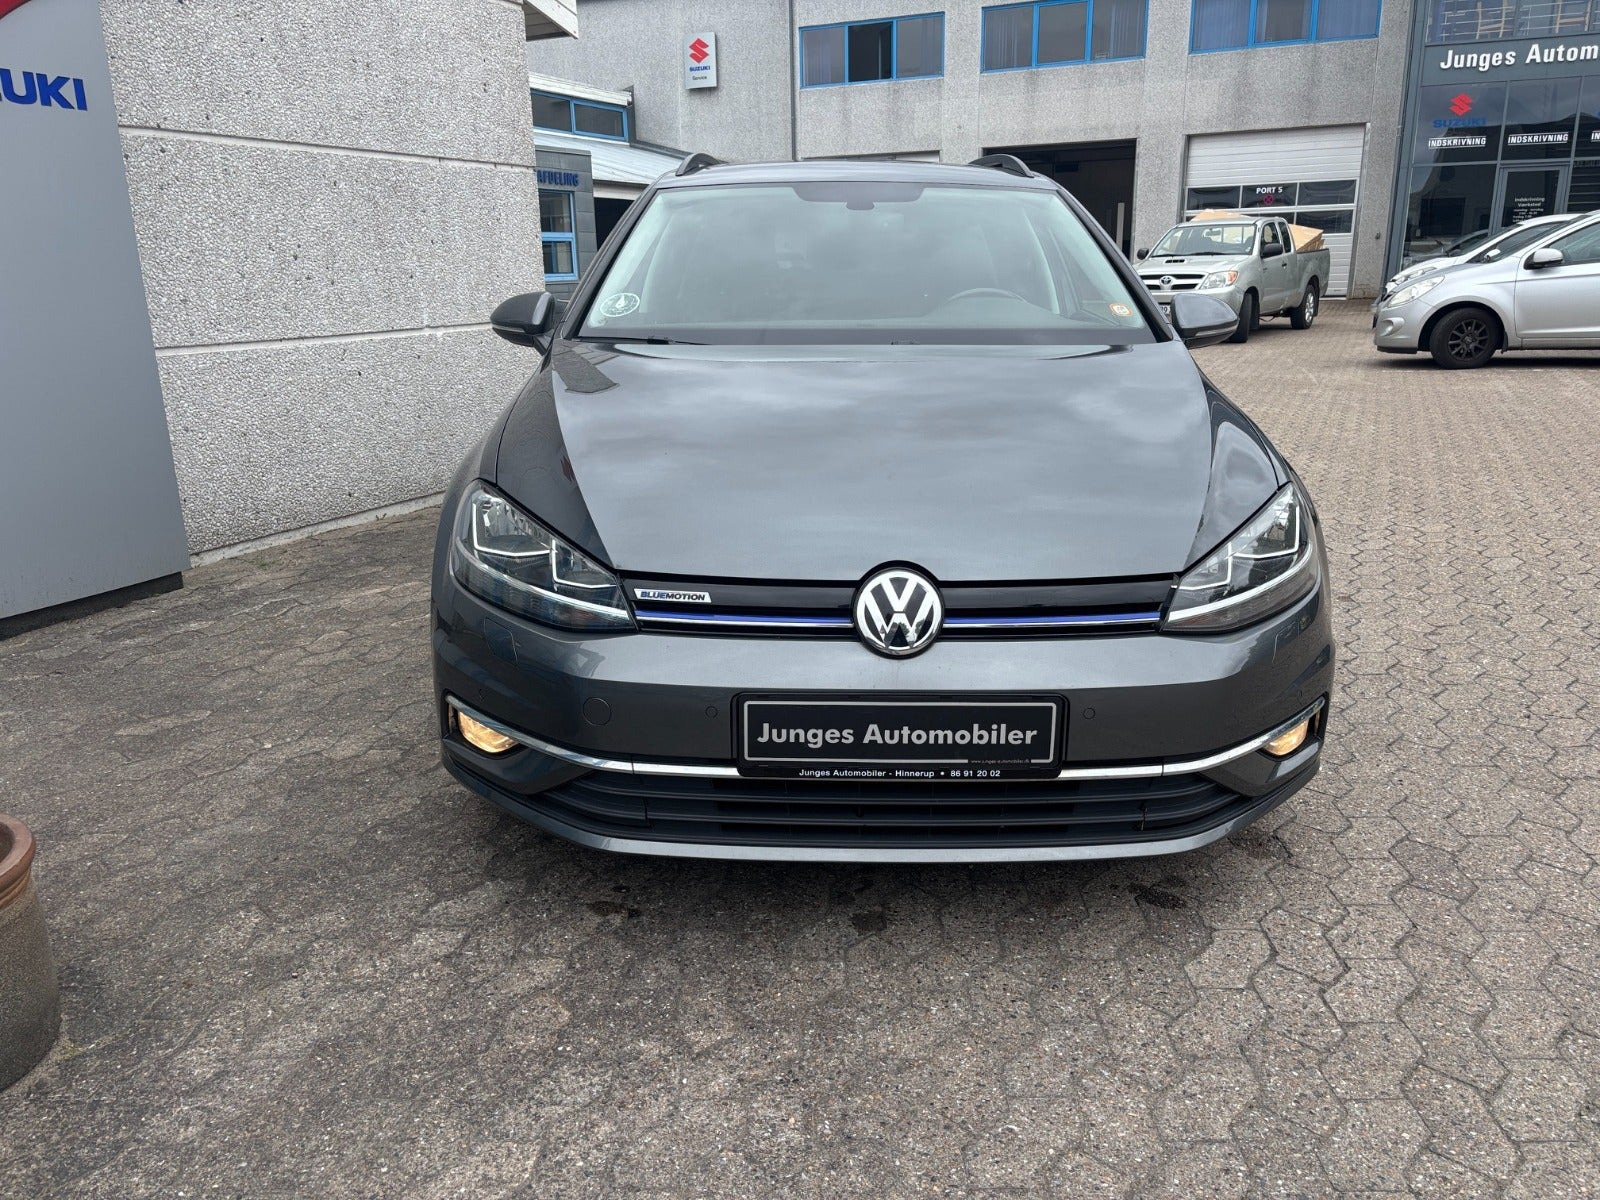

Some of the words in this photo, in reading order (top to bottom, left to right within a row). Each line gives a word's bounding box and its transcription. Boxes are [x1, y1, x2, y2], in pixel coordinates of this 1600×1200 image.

[1440, 49, 1516, 72] Junges
[1525, 43, 1599, 64] Autom
[0, 67, 88, 111] UKI
[1432, 117, 1487, 128] SUZUKI
[1428, 137, 1487, 147] INDSKRIVNING
[1507, 133, 1569, 144] INDSKRIVNING
[533, 169, 579, 187] AFDELING
[1256, 186, 1276, 194] PORT
[640, 591, 706, 601] BLUEMOTION
[757, 722, 854, 749] Junges
[863, 723, 1038, 745] Automobiler
[799, 769, 830, 778] Junges
[833, 768, 886, 777] Automobiler
[895, 769, 935, 779] Hinnerup
[950, 769, 961, 777] 86
